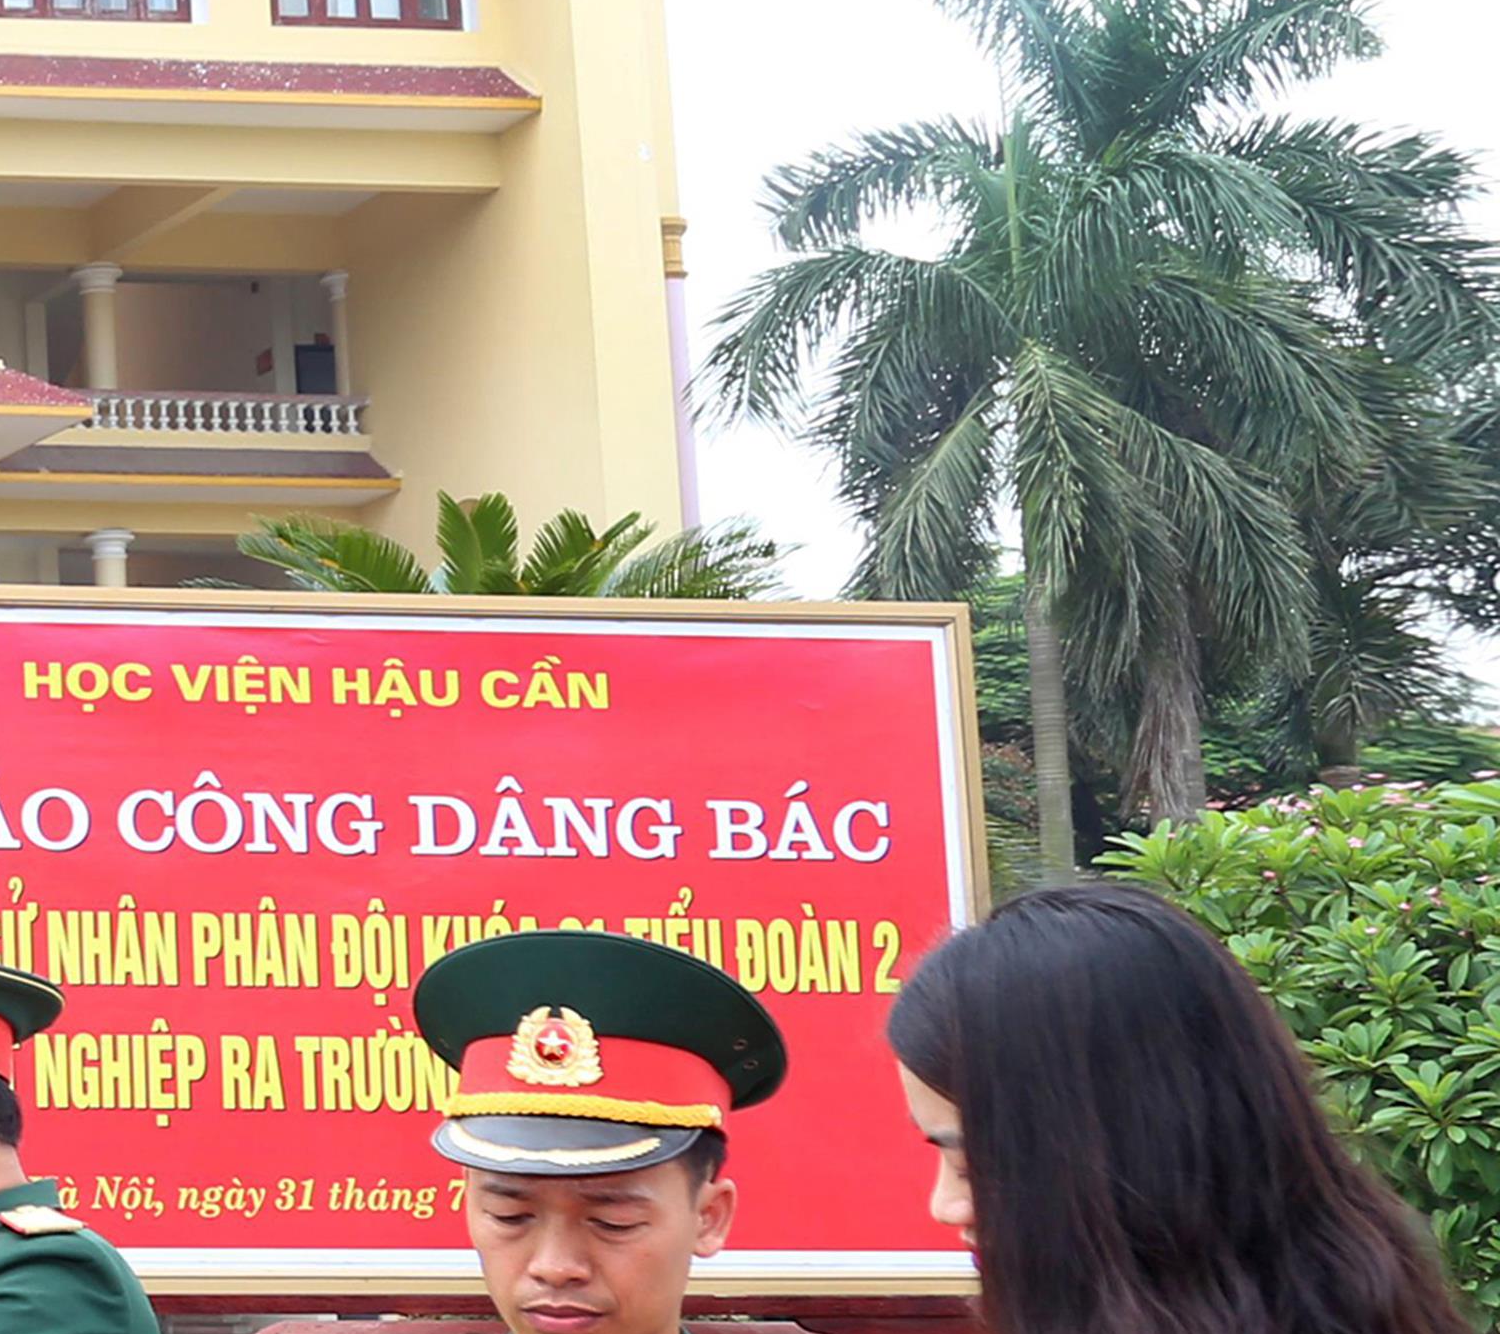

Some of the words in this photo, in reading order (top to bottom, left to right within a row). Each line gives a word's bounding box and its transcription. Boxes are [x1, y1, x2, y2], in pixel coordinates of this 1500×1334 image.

[23, 662, 153, 712] HỌC
[171, 656, 311, 714] VIỆN
[331, 658, 460, 717] HẬU
[480, 655, 610, 710] CẦN
[117, 771, 384, 856] CÔNG
[408, 775, 683, 860] DÂNG
[706, 780, 891, 863] BÁC
[46, 894, 178, 988] NHÂN
[191, 897, 320, 989] PHÂN
[330, 898, 410, 1005] ĐỘI
[735, 902, 862, 993] ĐOÀN
[872, 920, 902, 994] 2
[33, 1018, 208, 1127] NGHIỆP
[220, 1035, 285, 1111] RA
[294, 1016, 461, 1113] TRƯỜN
[27, 1175, 80, 1210] à
[91, 1176, 165, 1220] Nội,
[177, 1180, 266, 1219] ngày
[275, 1178, 316, 1211] 31
[328, 1177, 438, 1220] tháng
[447, 1178, 468, 1211] 7
